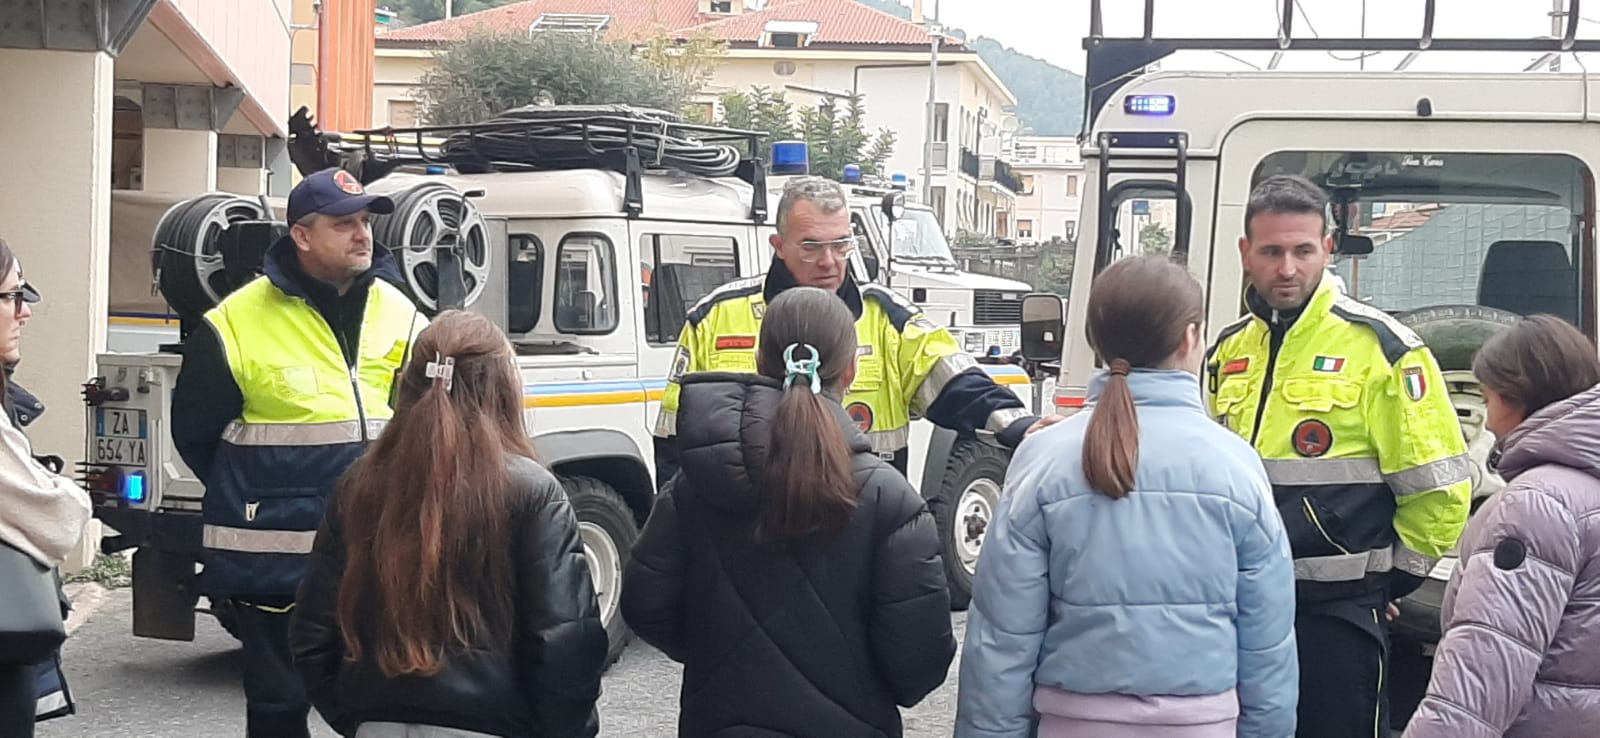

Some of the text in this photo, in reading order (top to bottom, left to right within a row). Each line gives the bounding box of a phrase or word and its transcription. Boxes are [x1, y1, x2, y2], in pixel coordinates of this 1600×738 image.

[112, 411, 129, 435] ZA
[97, 438, 145, 463] 654 YA
